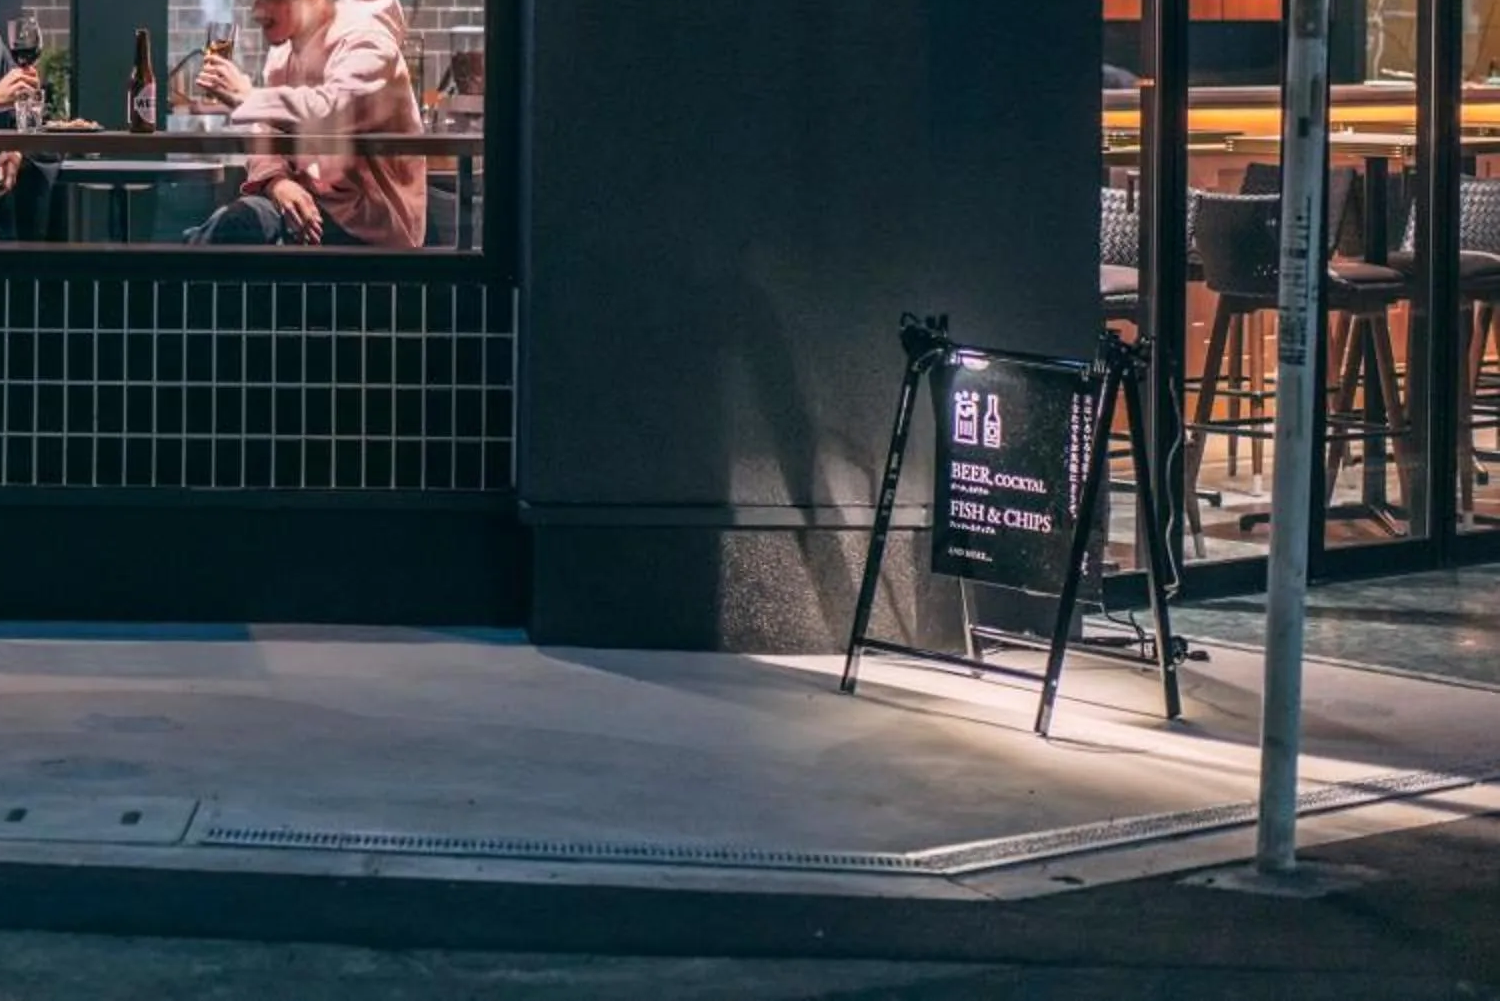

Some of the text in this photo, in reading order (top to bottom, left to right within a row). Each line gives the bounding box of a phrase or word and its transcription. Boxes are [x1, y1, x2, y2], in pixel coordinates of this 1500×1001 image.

[950, 500, 985, 522] FISH
[987, 506, 1001, 524] &
[1003, 508, 1052, 533] CHIPS
